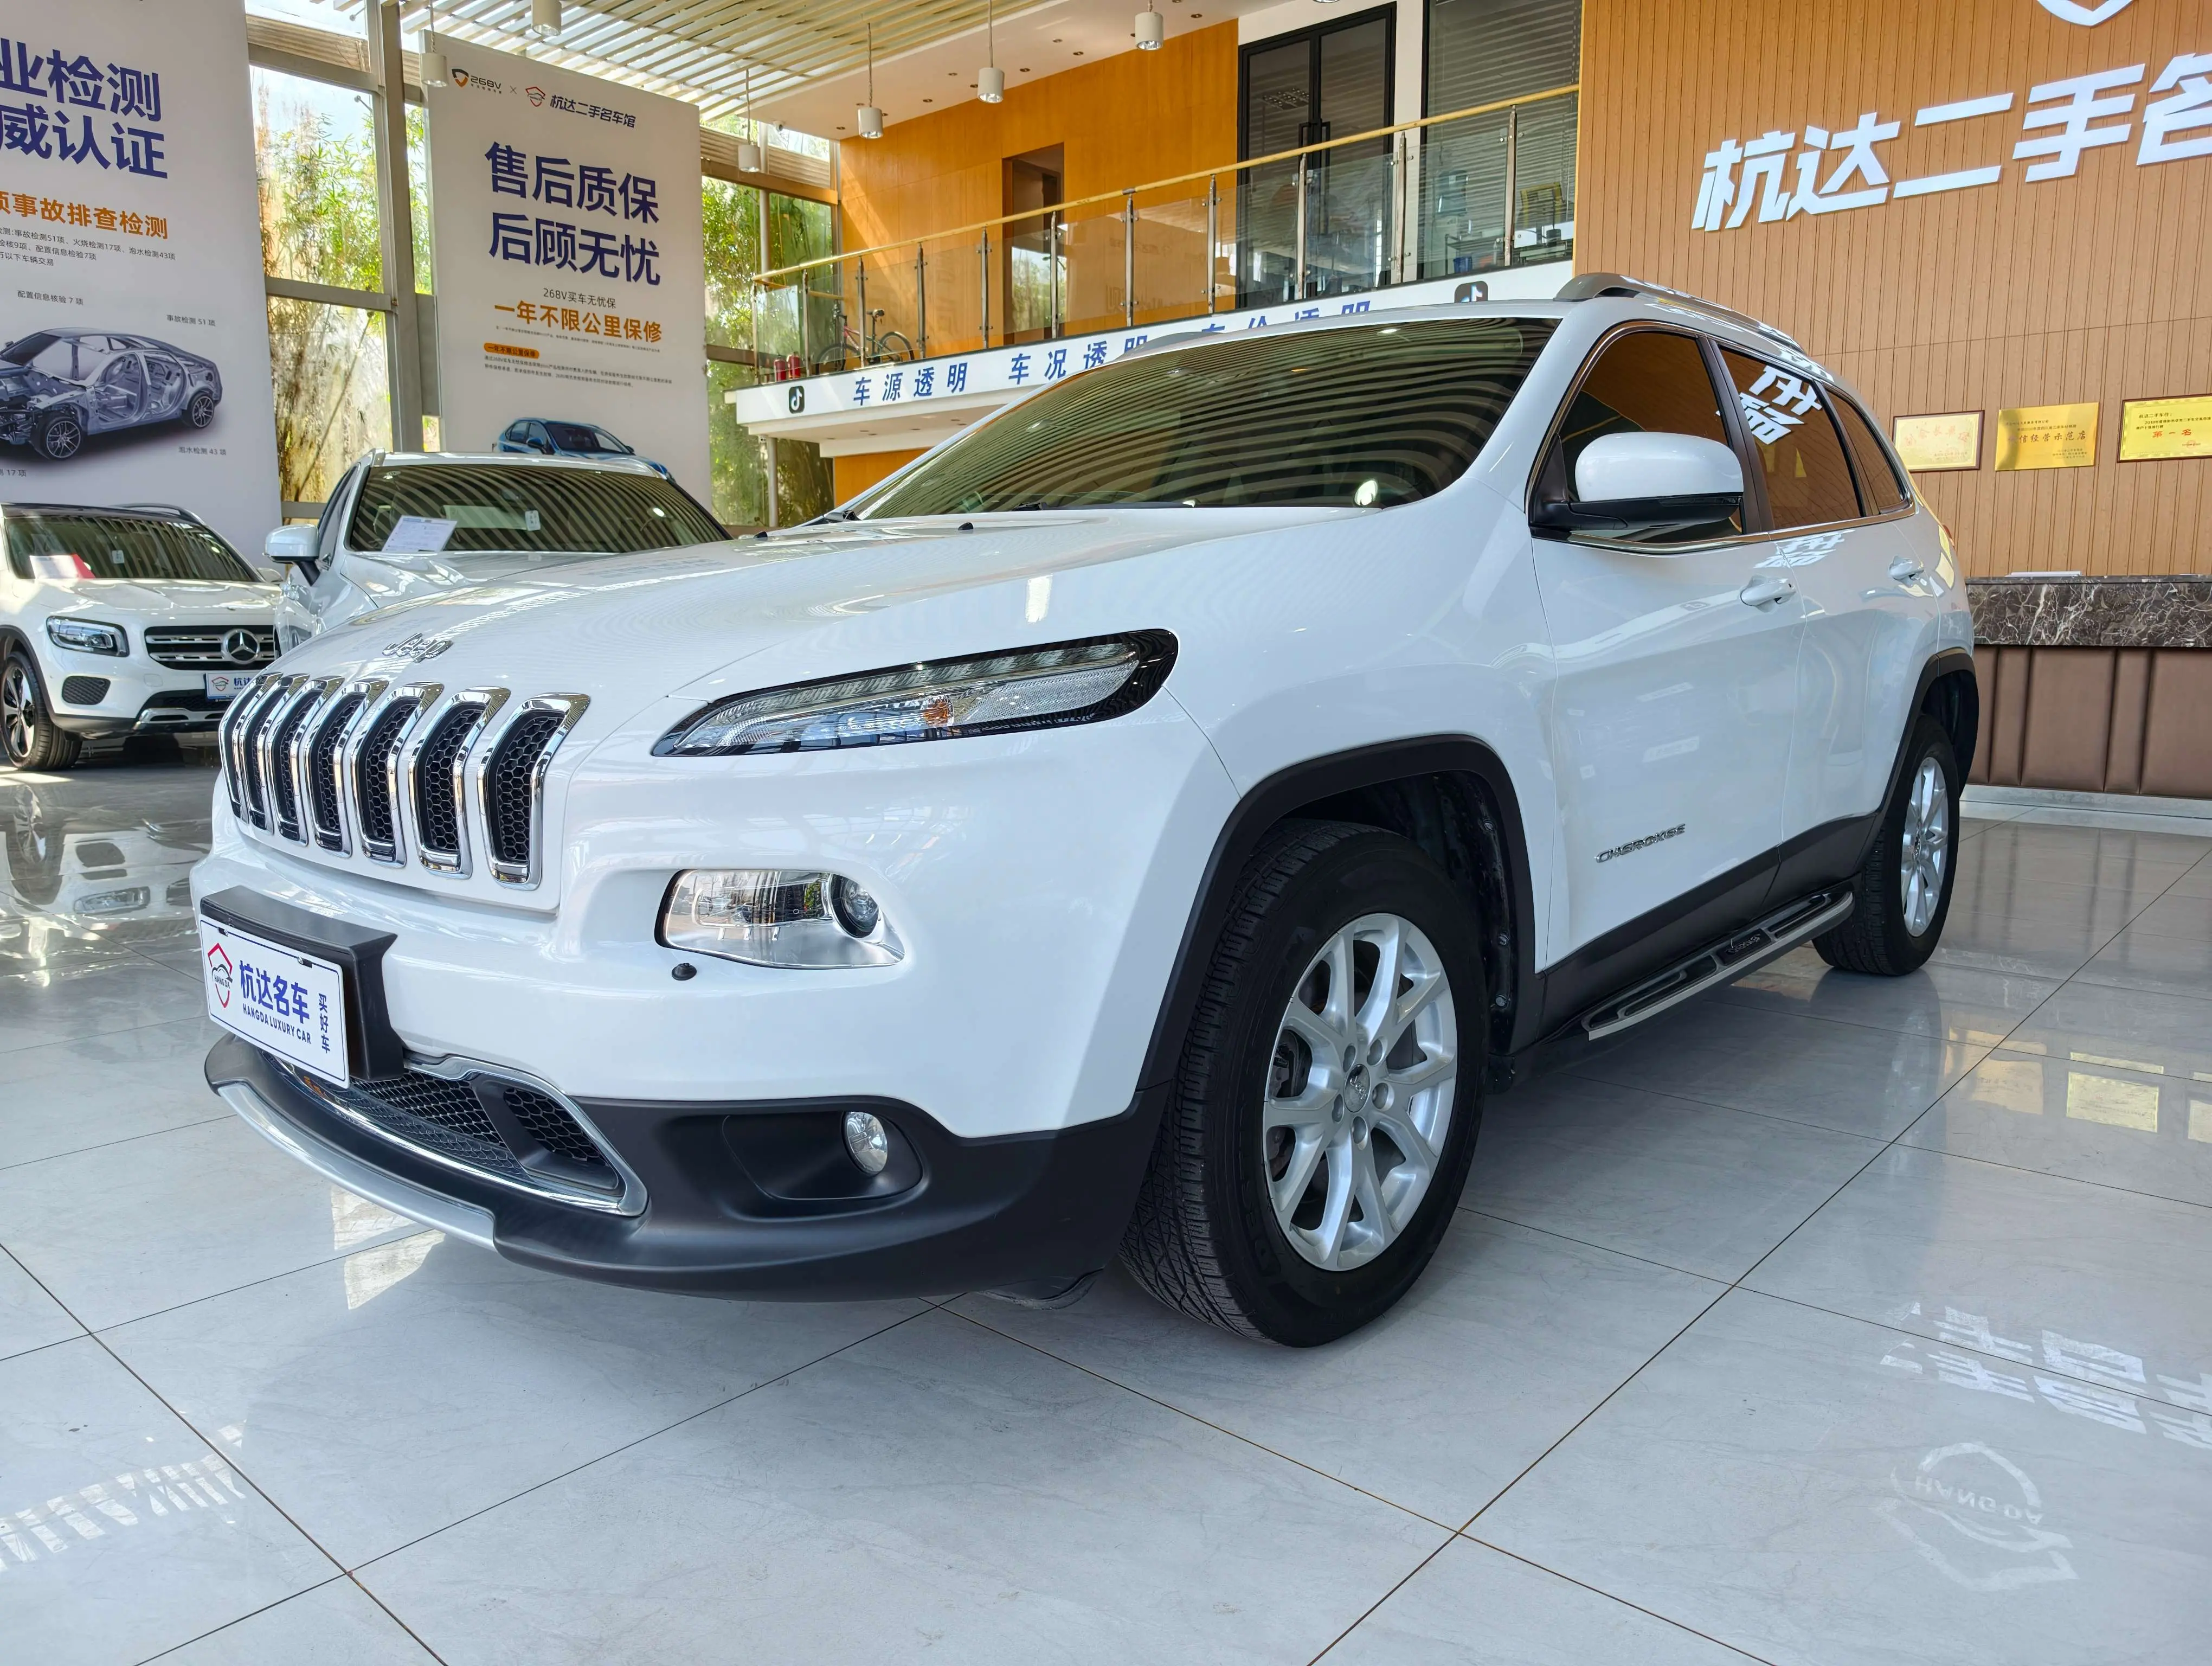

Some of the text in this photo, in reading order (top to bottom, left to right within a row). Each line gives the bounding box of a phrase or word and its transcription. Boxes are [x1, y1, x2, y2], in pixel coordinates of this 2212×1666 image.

[0, 38, 162, 122] 业检测
[471, 75, 501, 89] 268V
[550, 94, 636, 128] 杭达二手名车馆
[0, 103, 168, 179] 威认证
[485, 142, 659, 223] 售后质保
[489, 212, 660, 285] 后顾无忧
[543, 288, 616, 309] 268V买车无忧保
[494, 300, 663, 343] 一年不限公里保修
[853, 362, 968, 406] 车源透明
[1594, 823, 1686, 863] CHEROKEE
[214, 975, 224, 987] HANG
[239, 960, 310, 1024] 杭达名车
[243, 1003, 311, 1044] HANGDA LUXURY CAR
[318, 993, 330, 1054] 买好车
